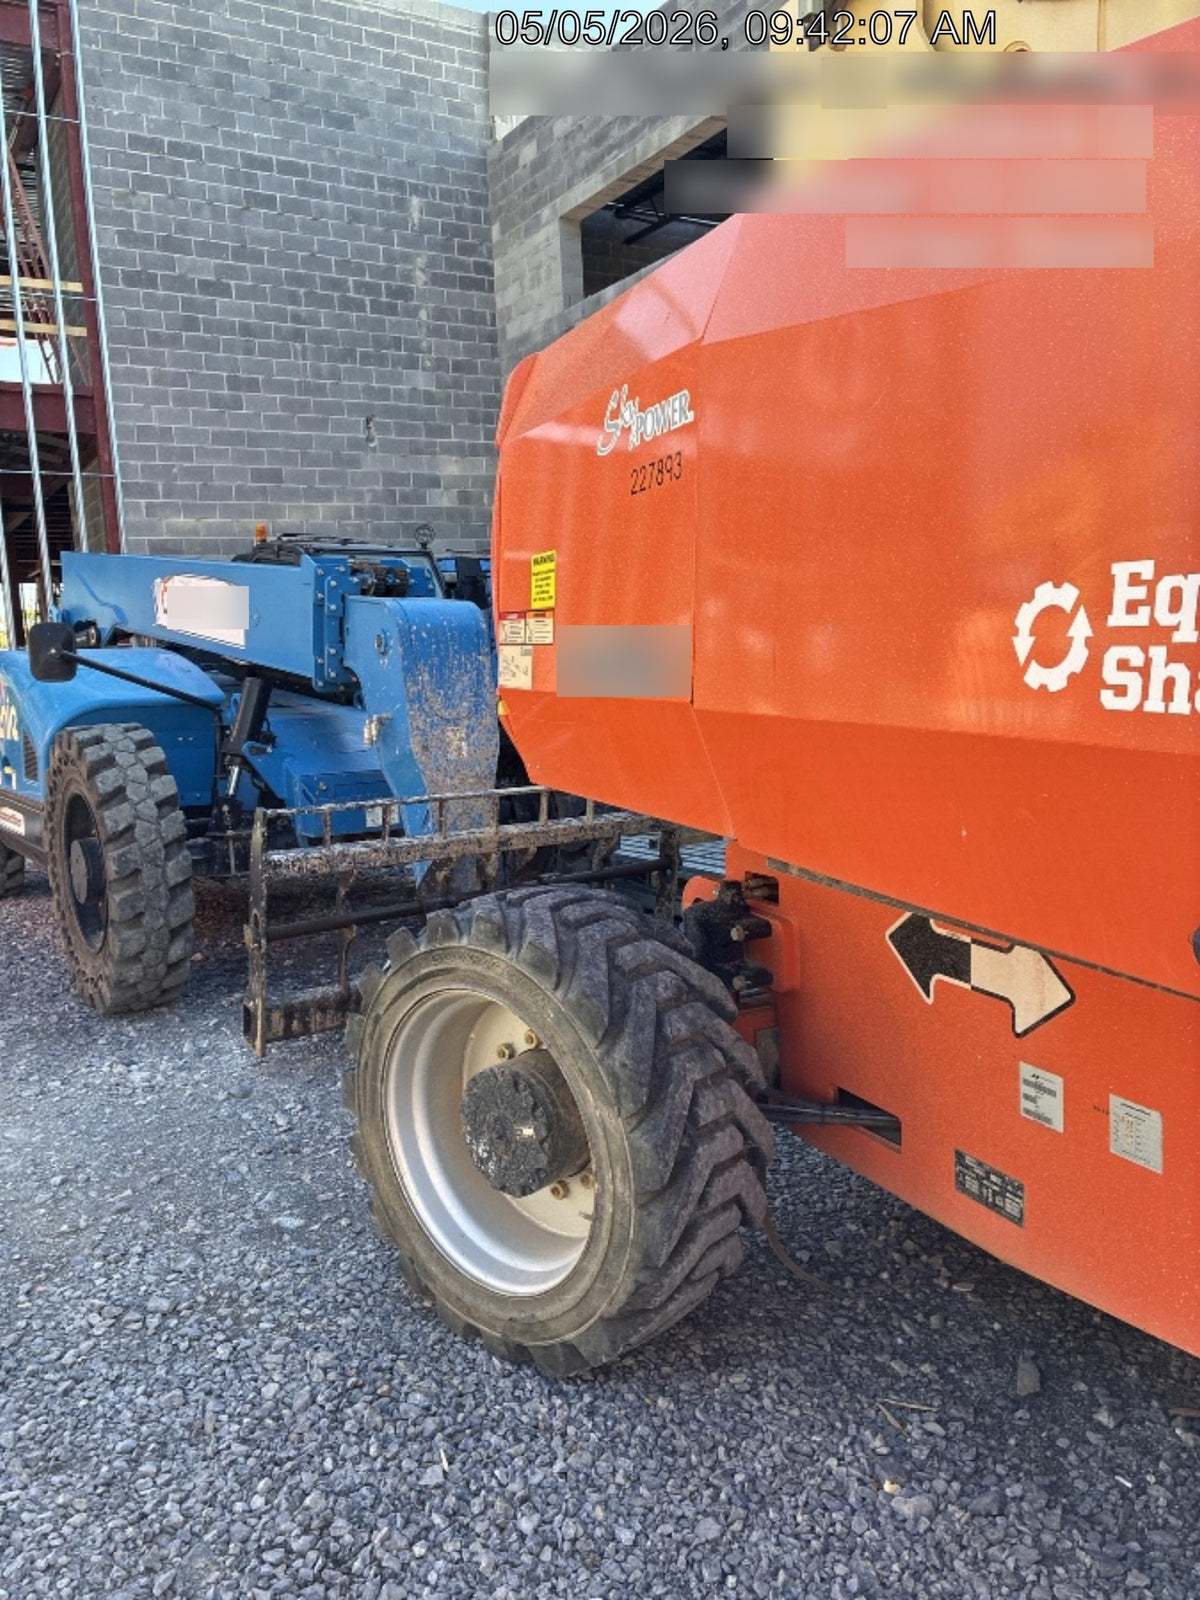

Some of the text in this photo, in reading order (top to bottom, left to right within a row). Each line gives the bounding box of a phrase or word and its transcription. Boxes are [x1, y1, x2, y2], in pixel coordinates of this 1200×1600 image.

[634, 389, 691, 447] POWER
[631, 451, 683, 496] 227893
[1099, 645, 1200, 716] Sh
